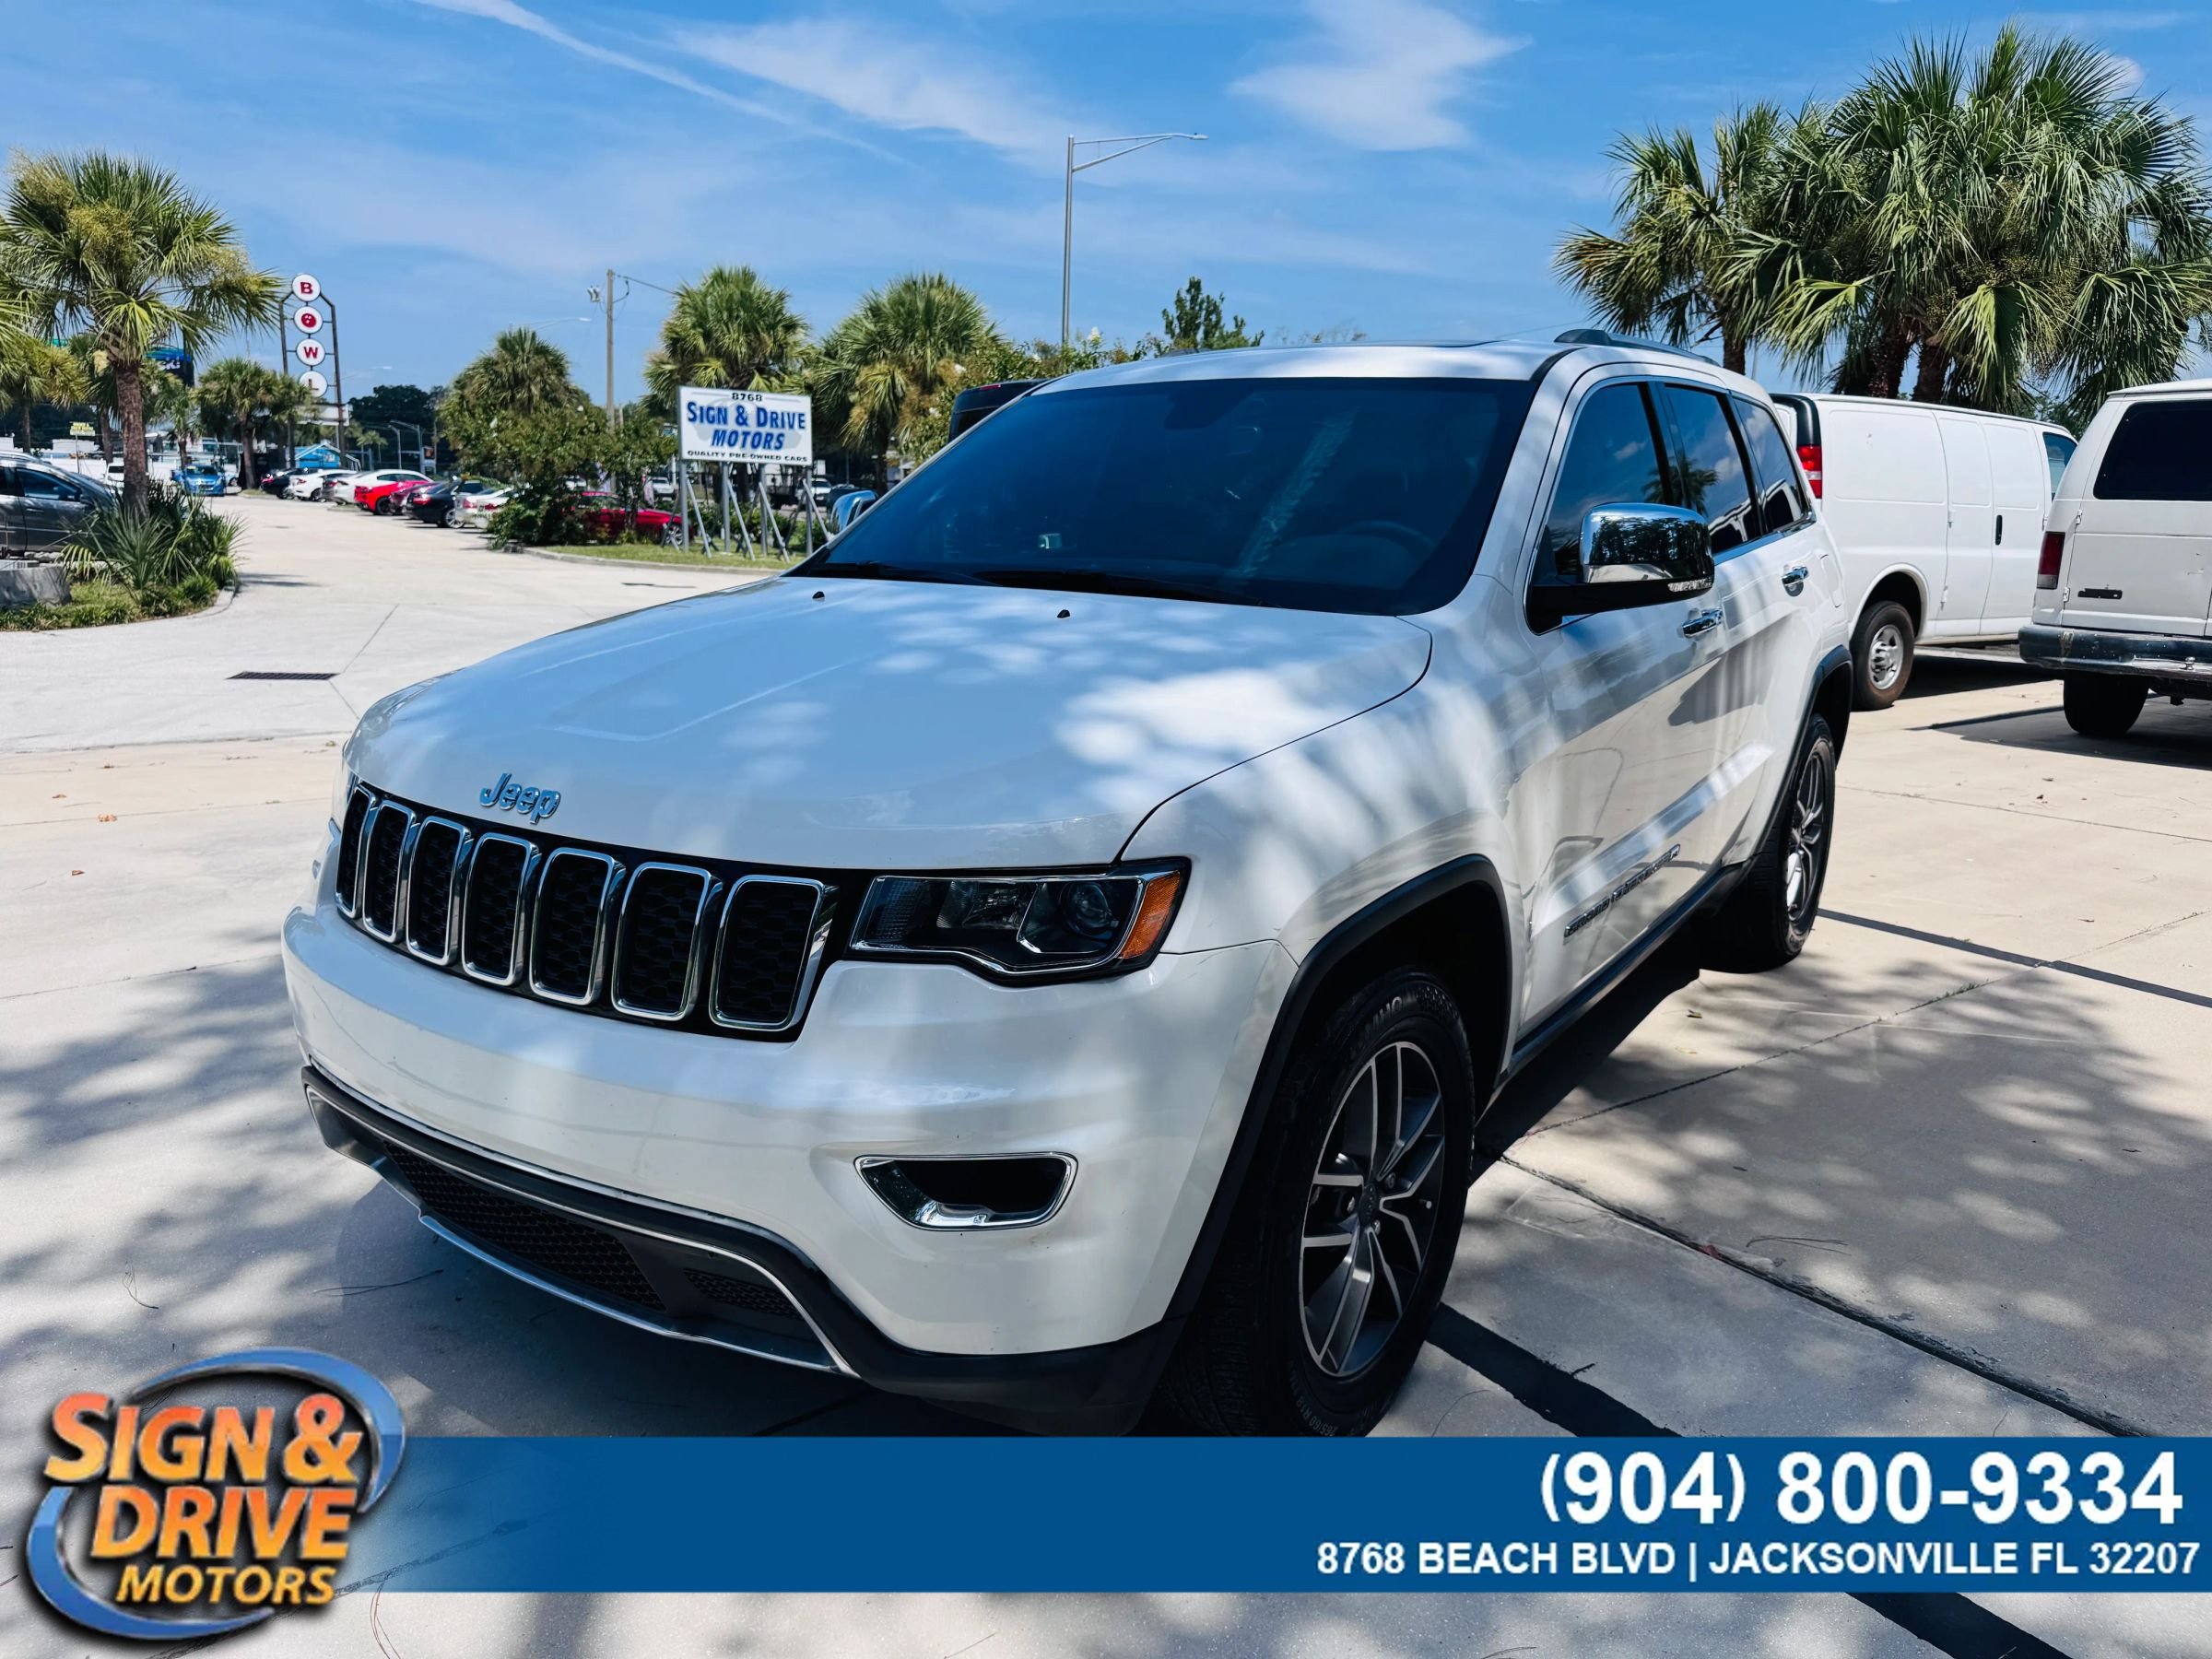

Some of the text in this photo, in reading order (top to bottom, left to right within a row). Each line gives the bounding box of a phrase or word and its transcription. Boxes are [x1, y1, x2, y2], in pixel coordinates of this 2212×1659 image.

[731, 392, 763, 402] 8768
[687, 401, 806, 429] SIGN & DRIVE
[711, 429, 785, 451] MOTORS
[728, 452, 782, 461] PRE-OWNED
[479, 772, 561, 826] Jeep
